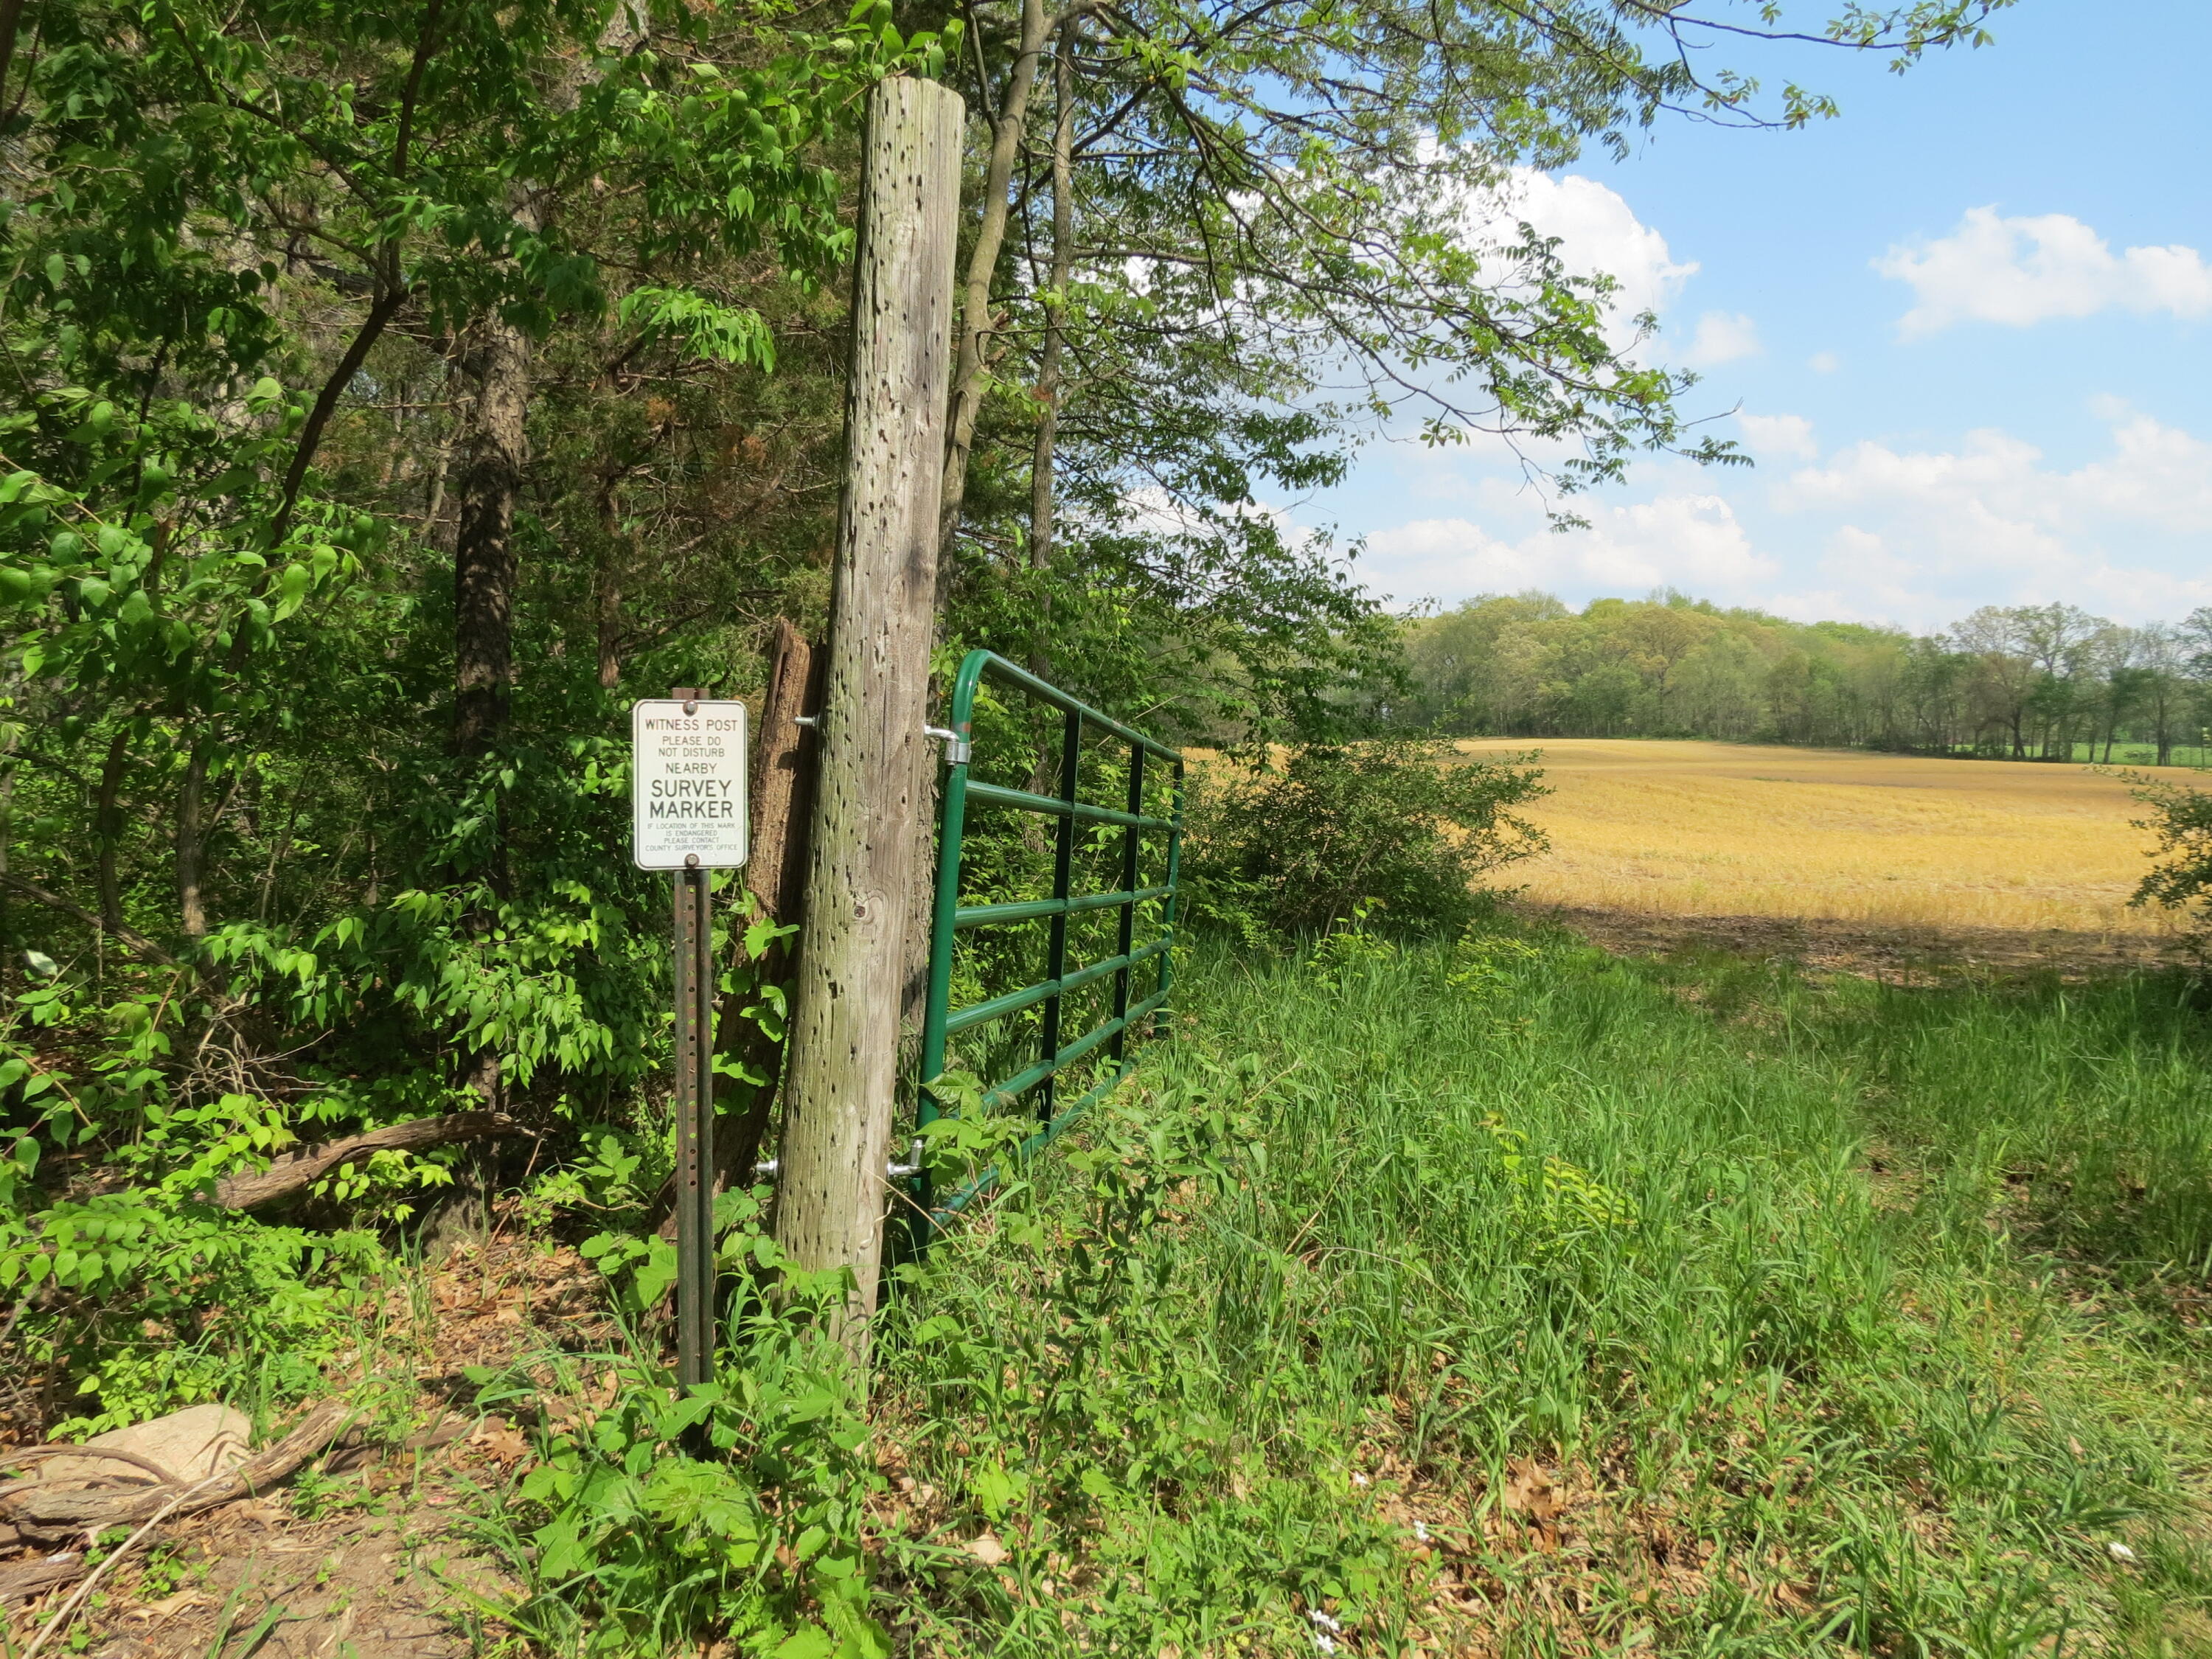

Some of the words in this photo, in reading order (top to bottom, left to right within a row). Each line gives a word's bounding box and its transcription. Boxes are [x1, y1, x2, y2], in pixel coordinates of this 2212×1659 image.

[645, 719, 699, 731] WITNESS
[706, 720, 737, 731] POST
[662, 736, 702, 745] PLEASE
[707, 736, 721, 745] DO
[658, 748, 678, 757] NOT
[683, 748, 725, 757] DISTURB
[666, 762, 717, 774] NEARBY
[652, 779, 731, 798] SURVEY
[650, 801, 733, 818] MARKER
